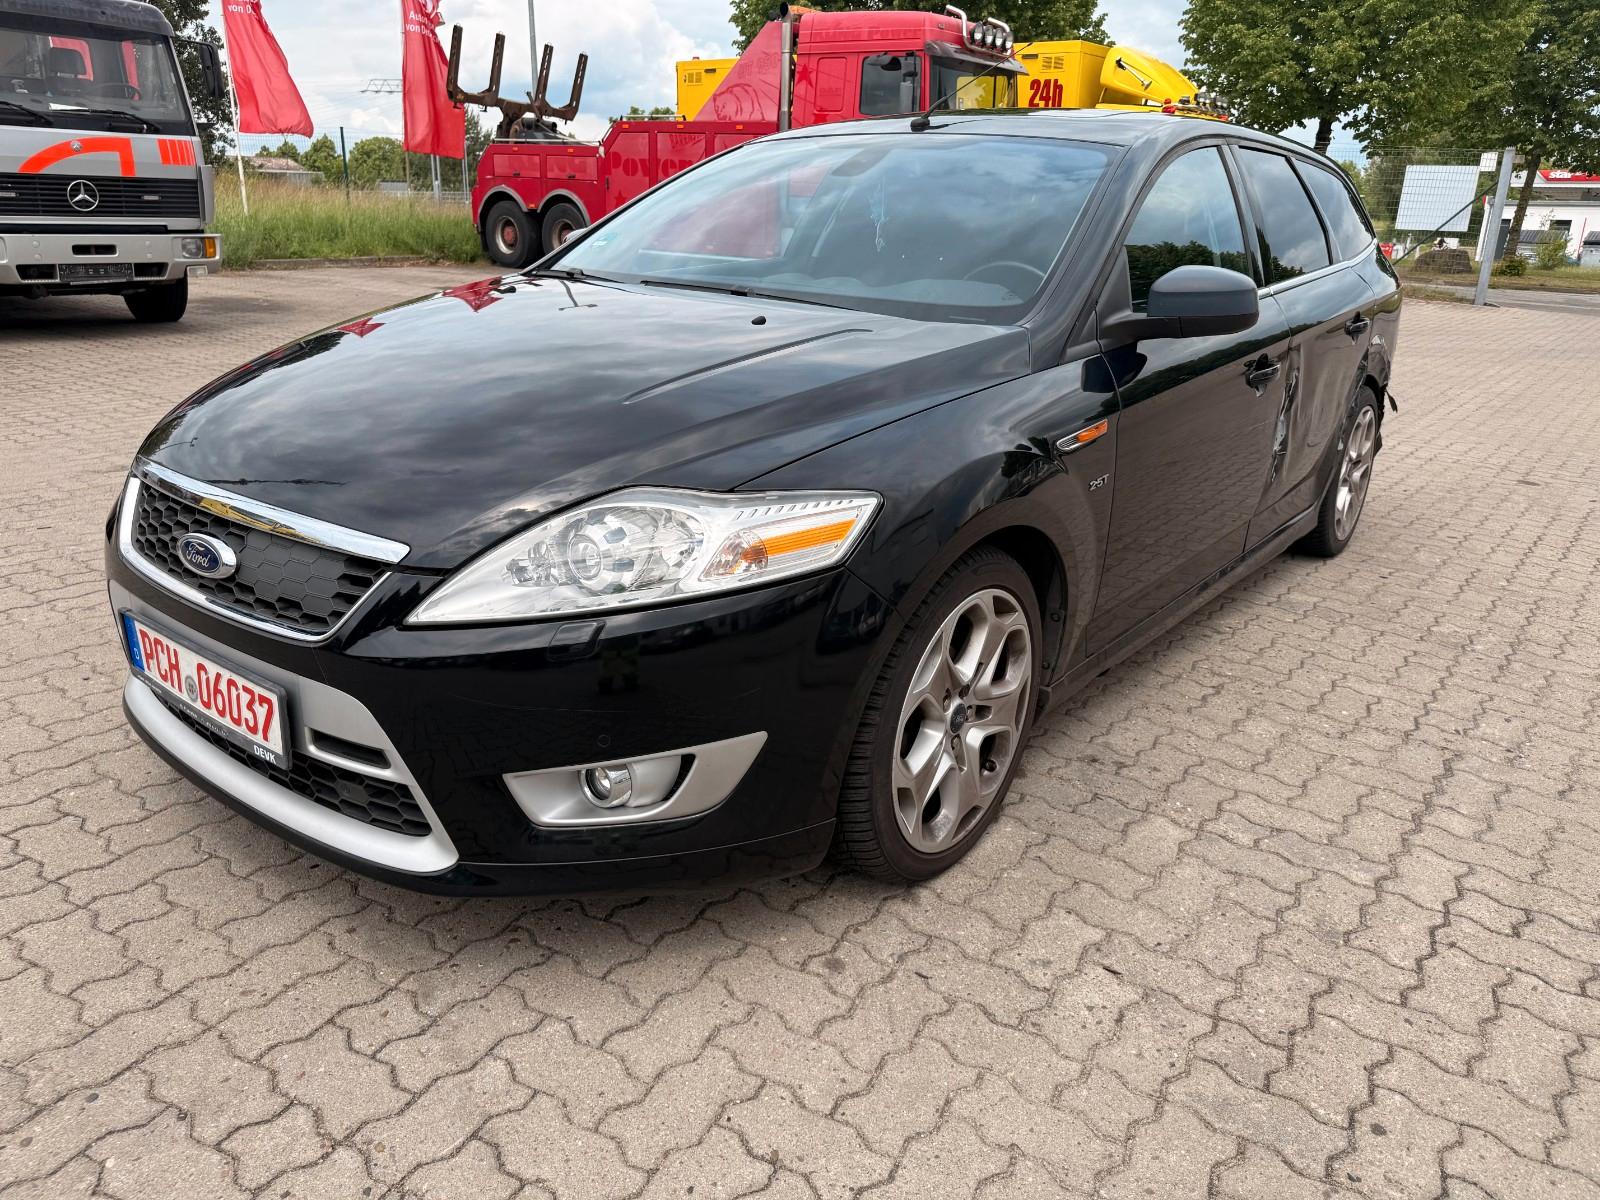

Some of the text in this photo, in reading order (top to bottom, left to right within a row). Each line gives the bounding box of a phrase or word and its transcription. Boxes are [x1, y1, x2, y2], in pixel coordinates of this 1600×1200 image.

[406, 24, 420, 33] von
[1028, 78, 1064, 108] 24h
[1548, 170, 1573, 179] star
[1089, 474, 1110, 491] 25T
[186, 543, 211, 567] Ford
[139, 629, 184, 694] PCH
[197, 662, 275, 743] 06037
[253, 744, 277, 765] DEVK
